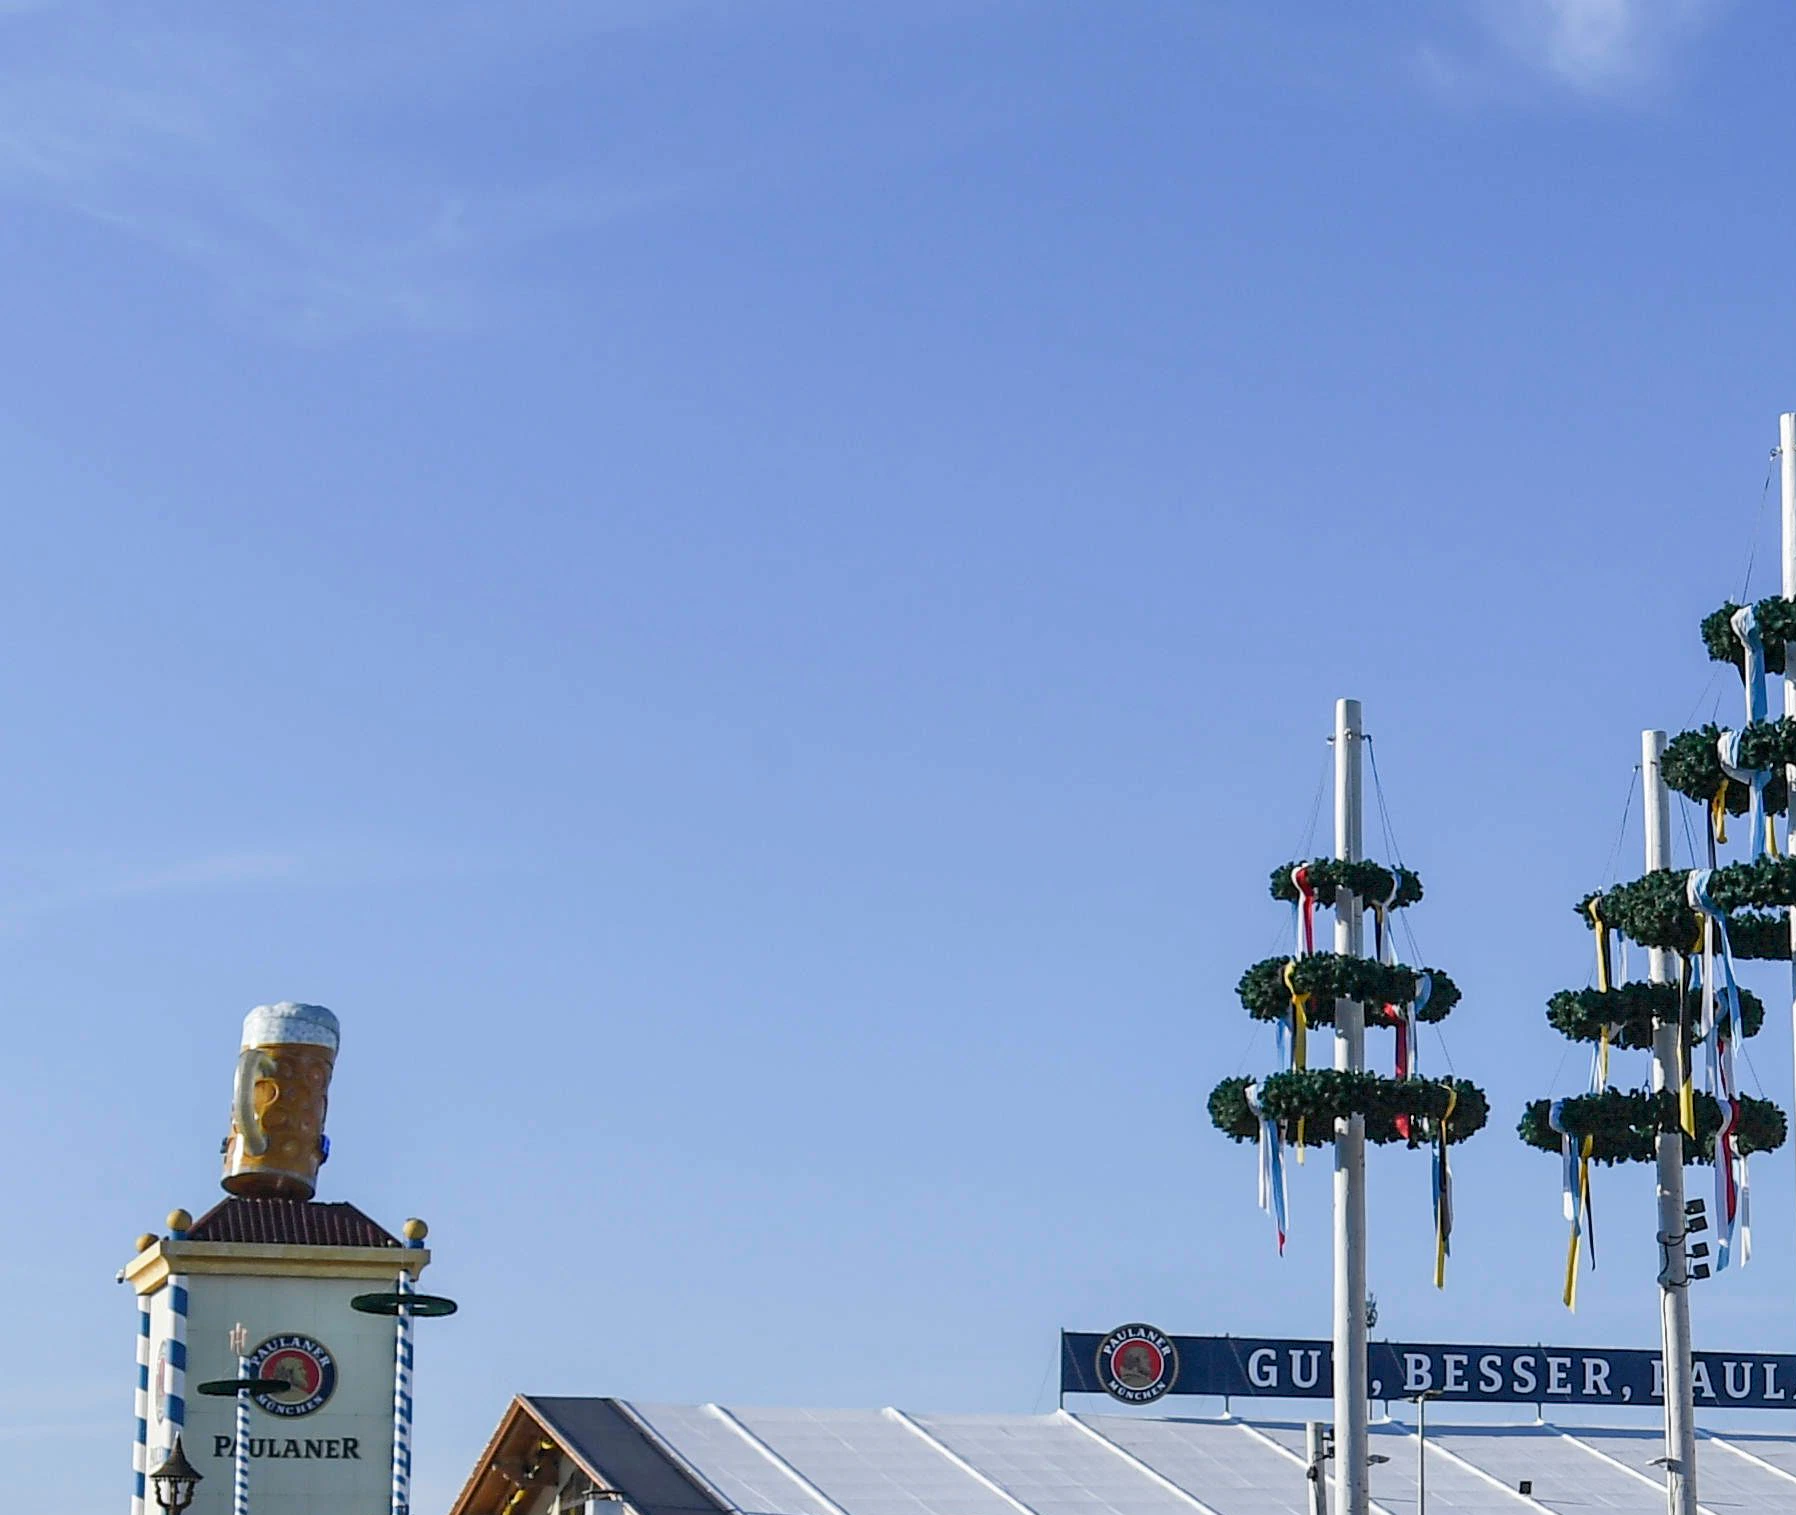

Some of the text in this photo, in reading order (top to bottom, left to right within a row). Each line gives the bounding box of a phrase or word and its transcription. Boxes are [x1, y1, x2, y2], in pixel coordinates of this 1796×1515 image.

[252, 1337, 330, 1367] PAULANER
[1103, 1328, 1172, 1356] PAULANER
[1247, 1347, 1384, 1396] GU,
[1403, 1353, 1633, 1402] BESSER,
